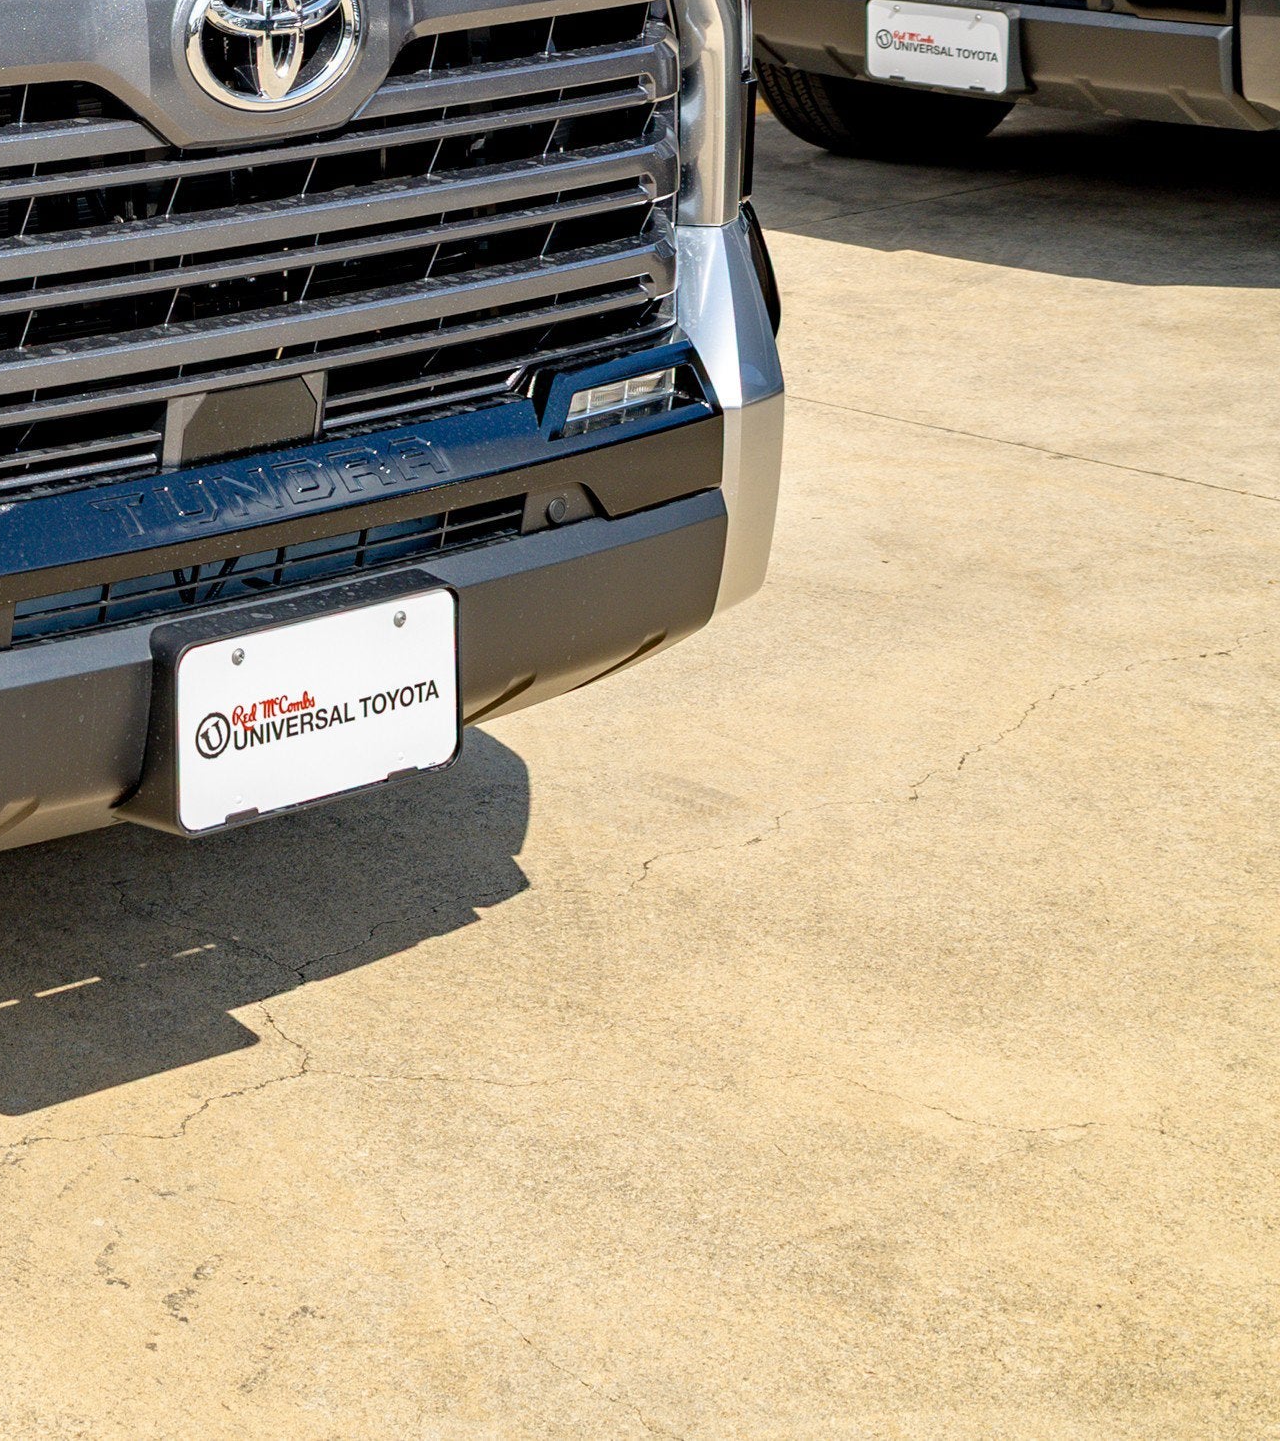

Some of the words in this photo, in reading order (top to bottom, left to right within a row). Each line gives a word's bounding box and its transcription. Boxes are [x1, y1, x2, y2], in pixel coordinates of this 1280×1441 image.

[893, 40, 954, 57] UNIVERSAL
[956, 48, 999, 62] TOYOTA
[90, 435, 452, 538] TUNDRA
[232, 705, 257, 731] Red
[259, 691, 315, 718] McCombs
[233, 702, 355, 751] UNIVERSAL
[359, 680, 439, 718] TOYOTA
